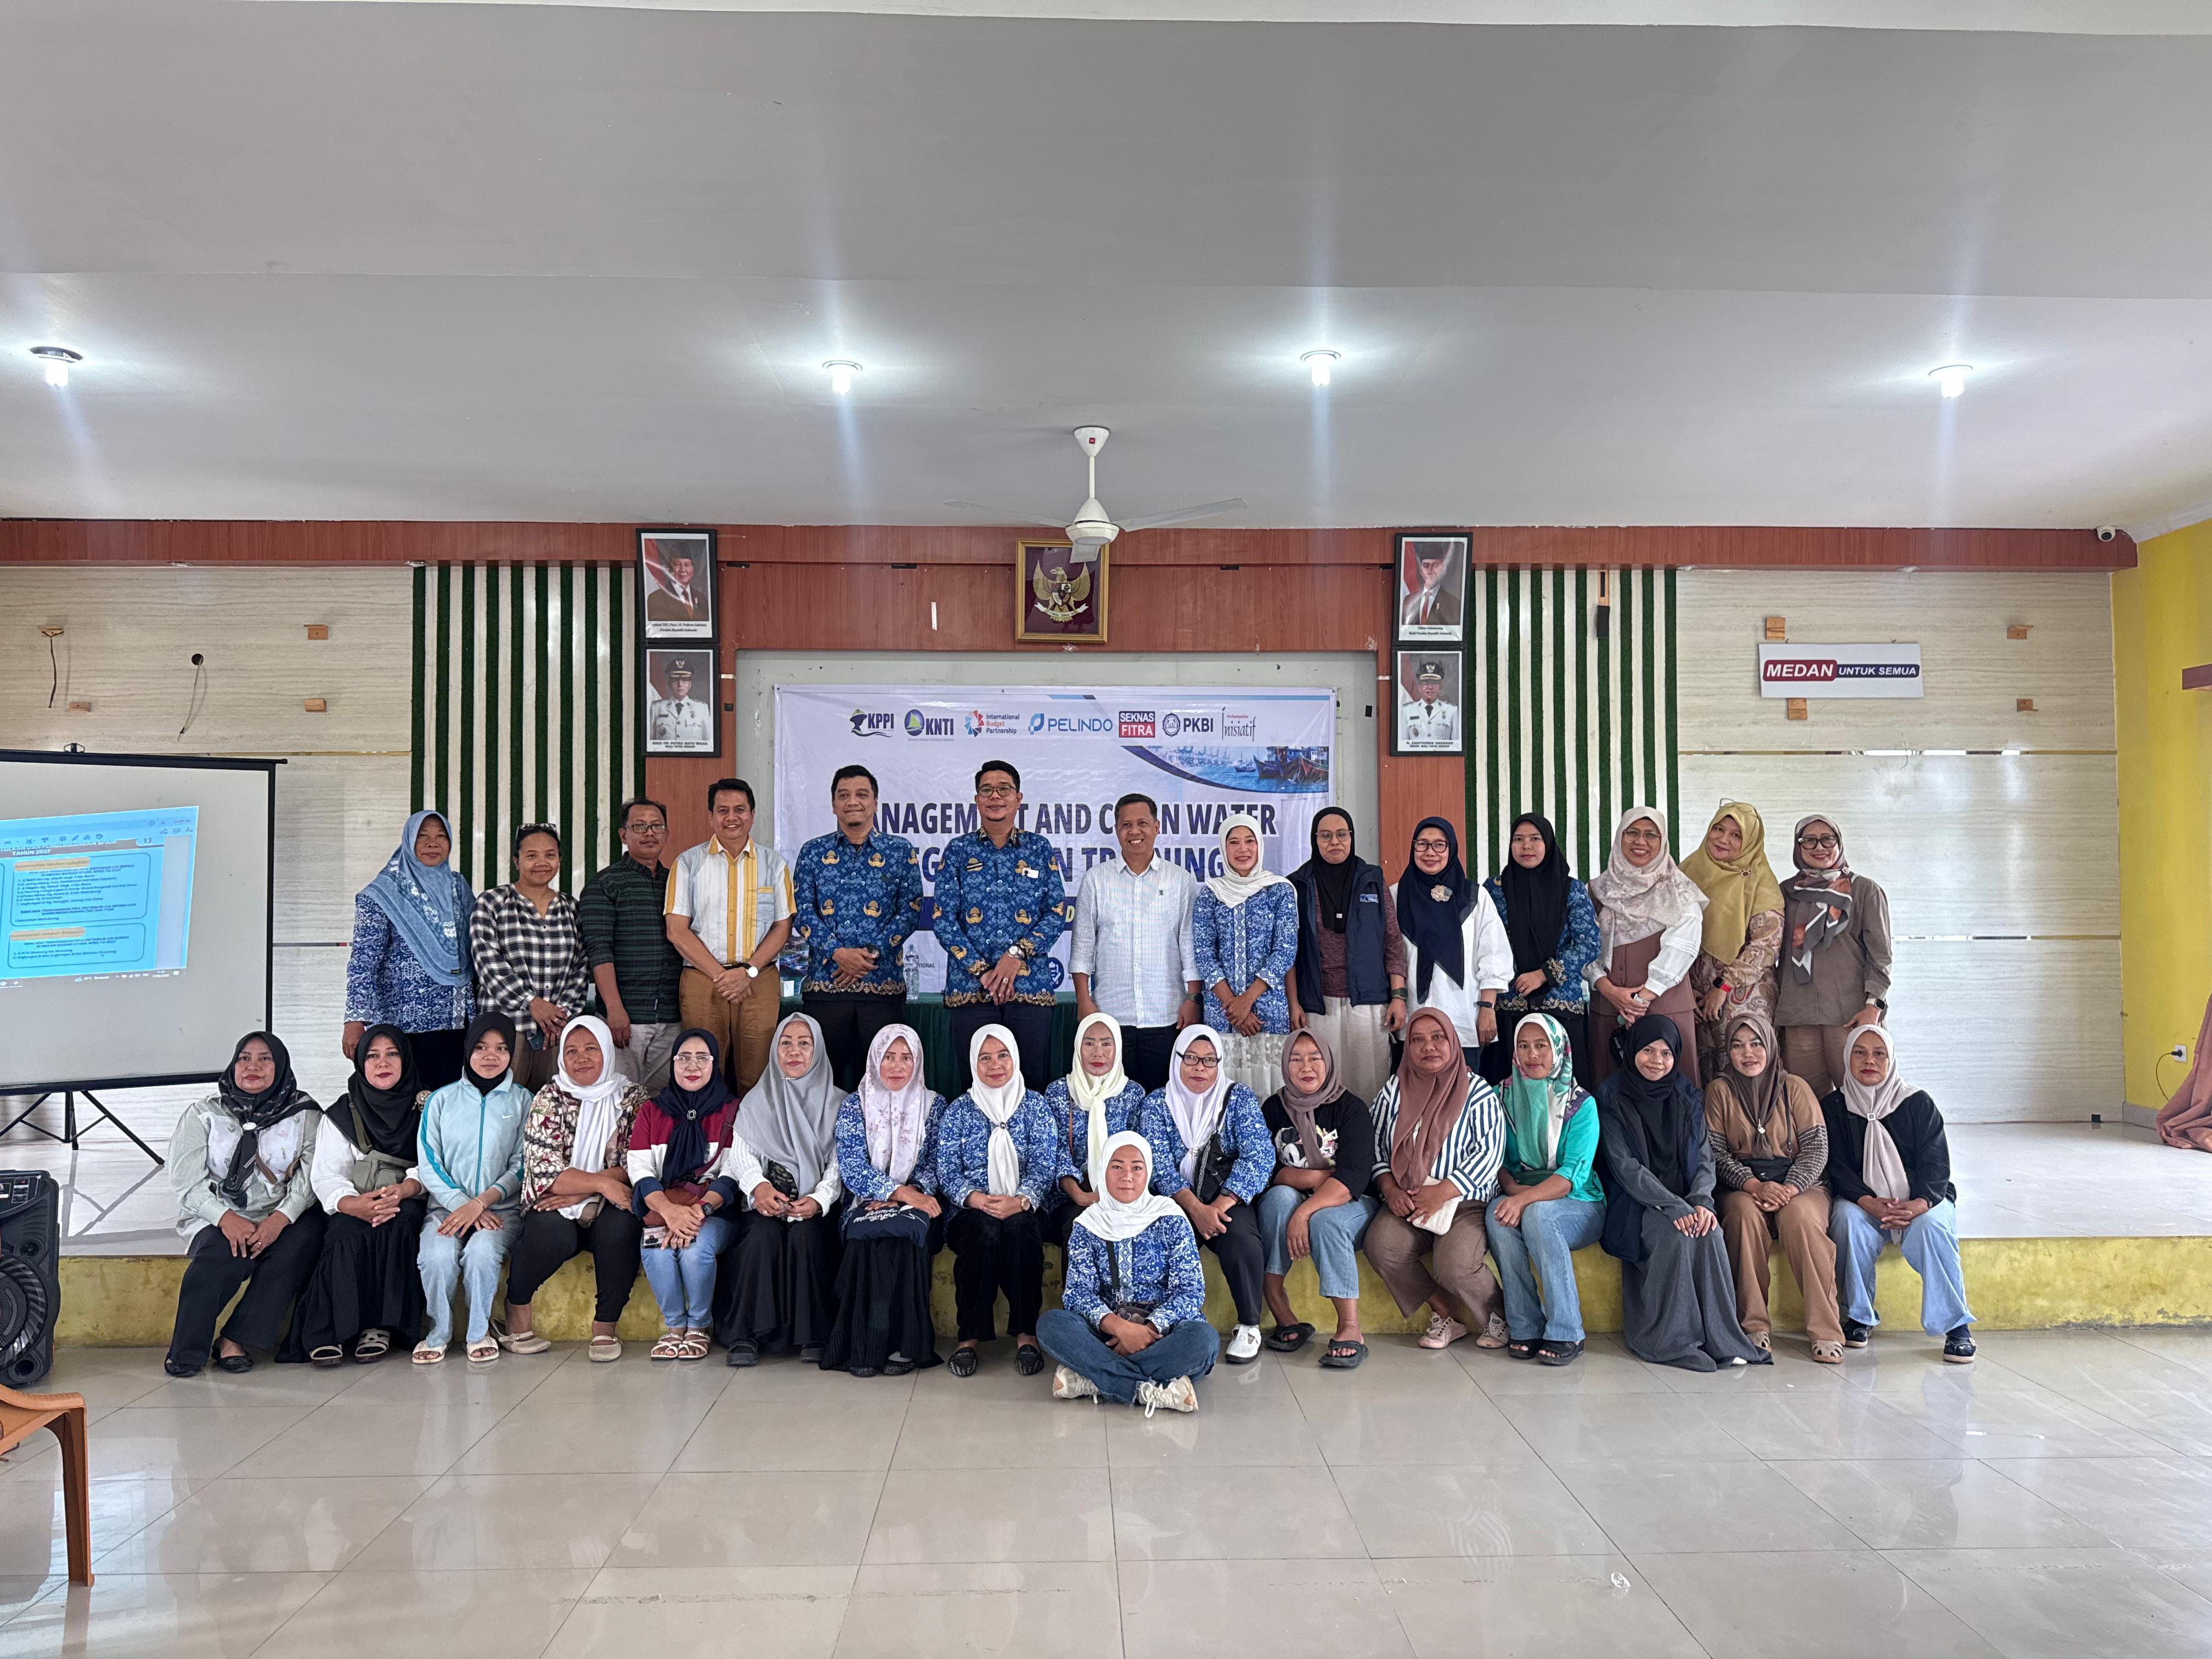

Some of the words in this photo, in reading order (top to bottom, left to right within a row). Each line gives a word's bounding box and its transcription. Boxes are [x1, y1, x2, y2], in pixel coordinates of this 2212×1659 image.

[1766, 664, 1834, 678] MEDAN
[1838, 666, 1876, 675] UNTUK
[1878, 667, 1917, 675] SEMUA
[868, 713, 894, 729] KPPI
[1120, 712, 1154, 723] SEKNAS
[926, 718, 954, 736] KNTI
[1048, 718, 1113, 732] PELINDO
[1121, 724, 1153, 736] FITRA
[1183, 718, 1214, 732] PKBI
[872, 803, 1029, 834] NAGEMT
[1034, 803, 1092, 834] AND
[1081, 847, 1226, 883] TING
